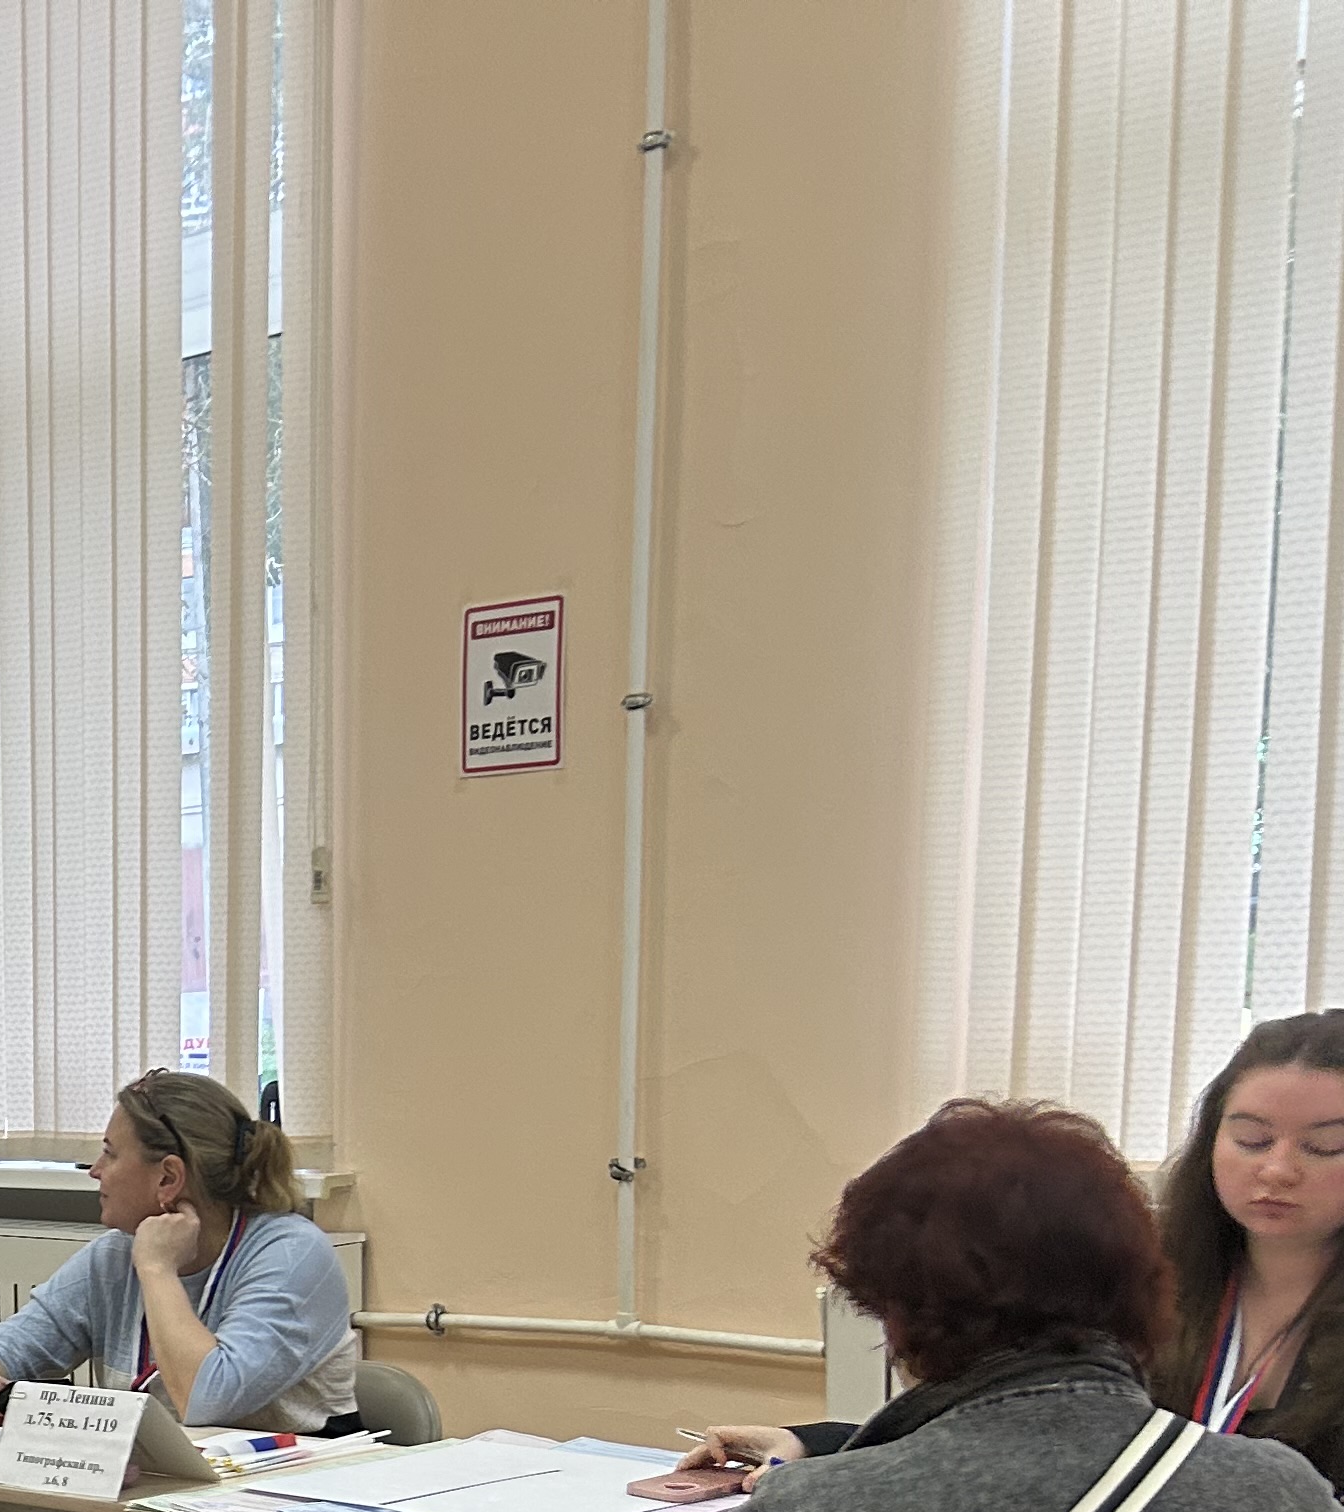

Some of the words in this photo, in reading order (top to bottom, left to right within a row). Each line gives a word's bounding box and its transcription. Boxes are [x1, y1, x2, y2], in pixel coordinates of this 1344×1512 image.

[475, 613, 550, 636] ВНИМАНИЕ!
[469, 715, 552, 741] ВЕДЁТСЯ
[39, 1390, 61, 1405] пр.
[63, 1389, 116, 1407] Ленина
[58, 1417, 79, 1430] кв.
[82, 1416, 119, 1433] 1-119
